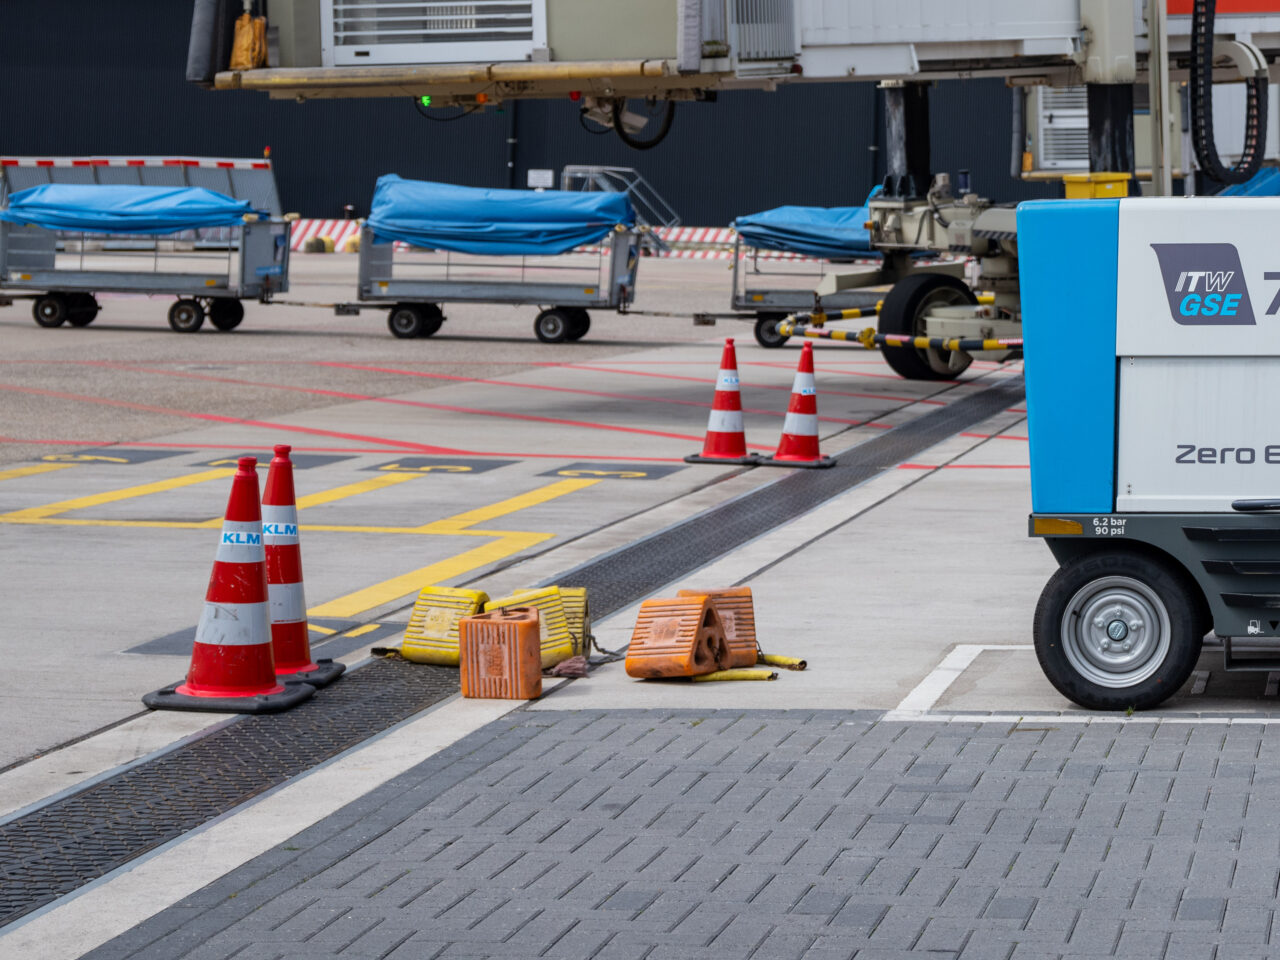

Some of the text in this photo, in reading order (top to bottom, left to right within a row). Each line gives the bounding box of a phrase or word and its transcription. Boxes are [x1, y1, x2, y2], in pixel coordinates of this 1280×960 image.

[1174, 271, 1235, 292] ITW
[1179, 293, 1242, 317] GSE
[1175, 444, 1256, 465] Zero
[1093, 517, 1127, 526] 6.2 bar
[262, 523, 297, 536] KLM
[1095, 526, 1125, 536] 90 psi
[223, 532, 260, 545] KLM
